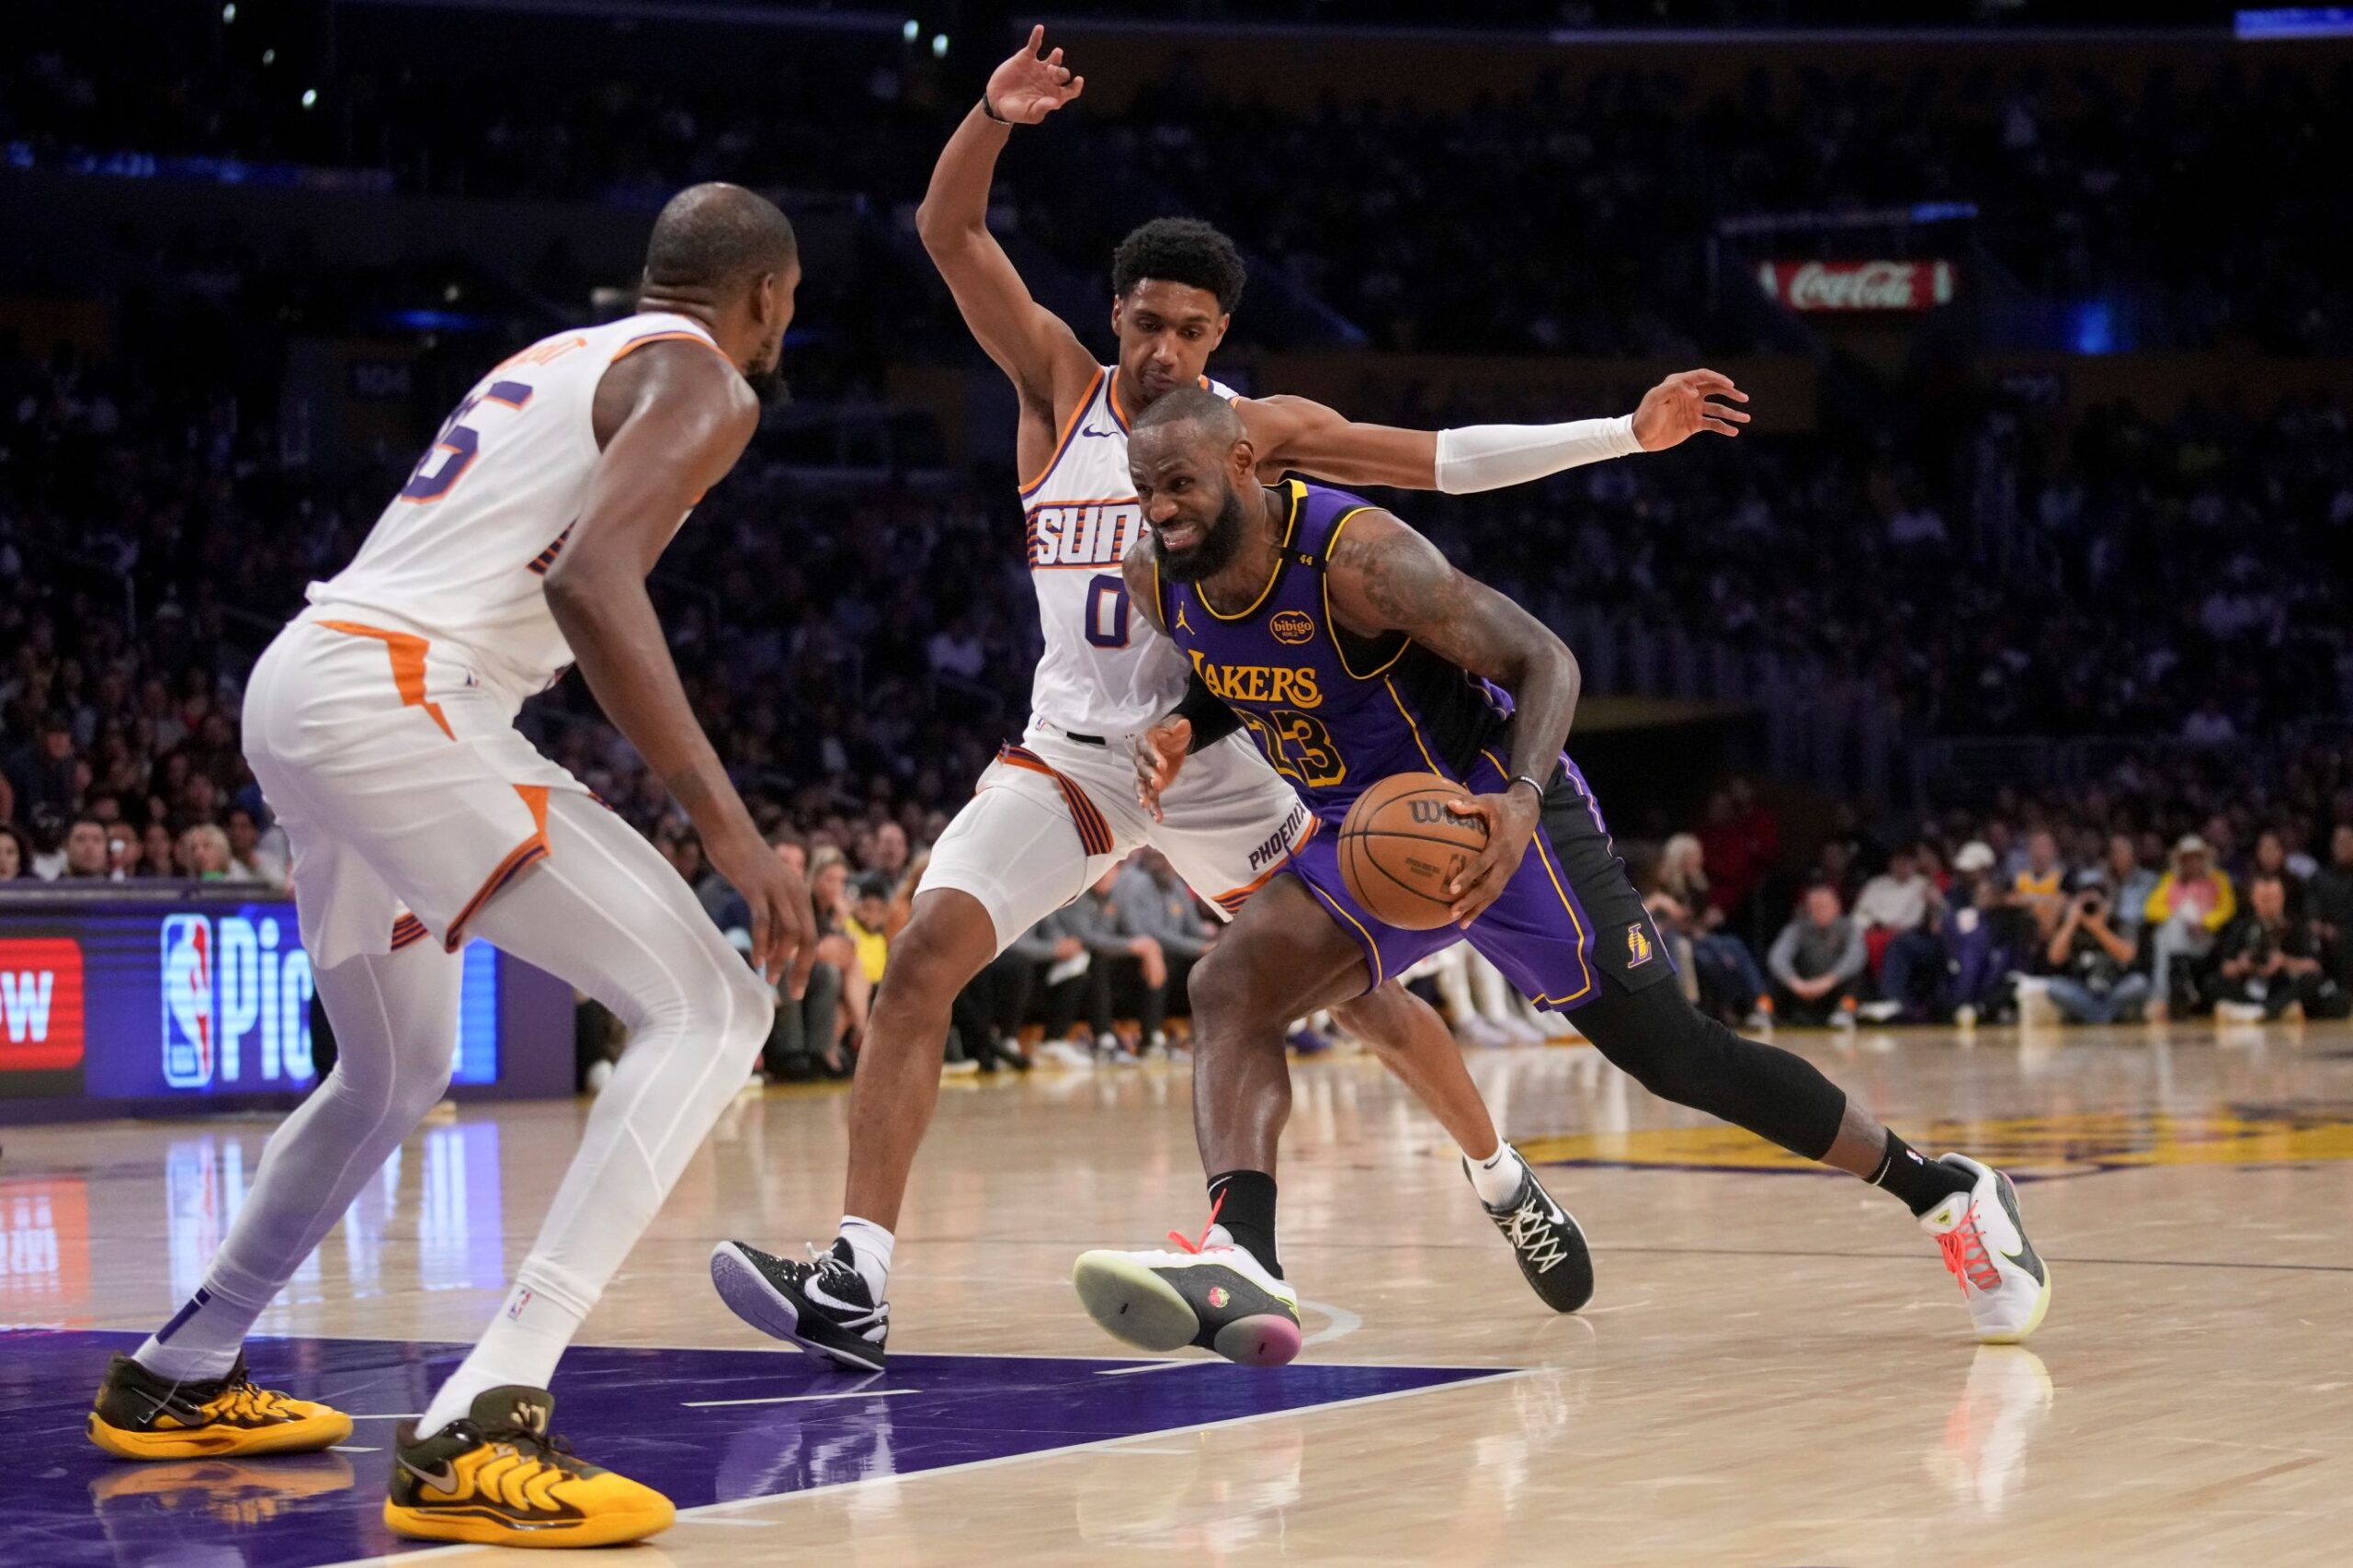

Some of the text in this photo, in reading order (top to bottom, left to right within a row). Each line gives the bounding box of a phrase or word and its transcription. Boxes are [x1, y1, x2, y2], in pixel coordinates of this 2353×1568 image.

[1037, 505, 1152, 564] SUN
[1300, 554, 1313, 566] 44
[1086, 574, 1132, 649] 0
[1273, 619, 1312, 635] bibigo
[1188, 649, 1323, 709] LAKERS
[1231, 707, 1347, 788] 23
[1248, 797, 1306, 871] PHOENIX
